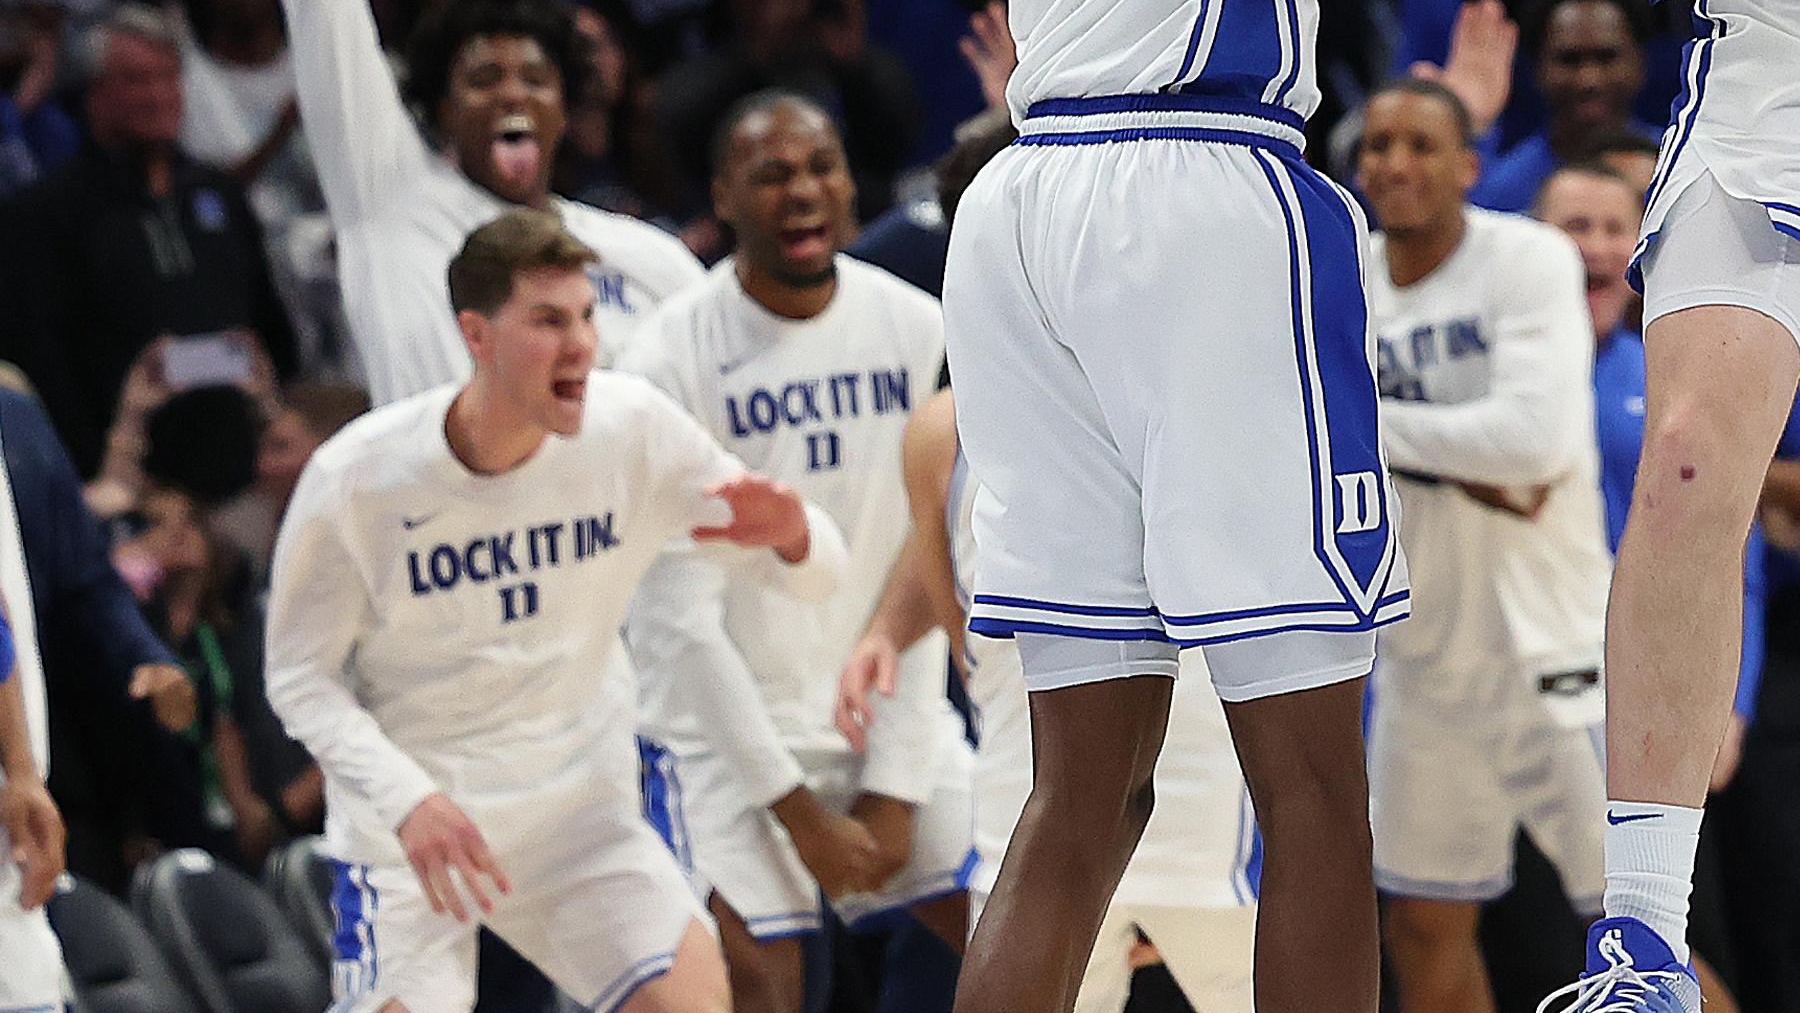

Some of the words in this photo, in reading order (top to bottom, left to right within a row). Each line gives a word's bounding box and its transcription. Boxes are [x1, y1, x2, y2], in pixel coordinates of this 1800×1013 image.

[725, 376, 822, 438] LOCK
[830, 372, 859, 418] IT
[1334, 471, 1380, 534] D
[407, 530, 520, 597] LOCK
[527, 521, 565, 570] IT
